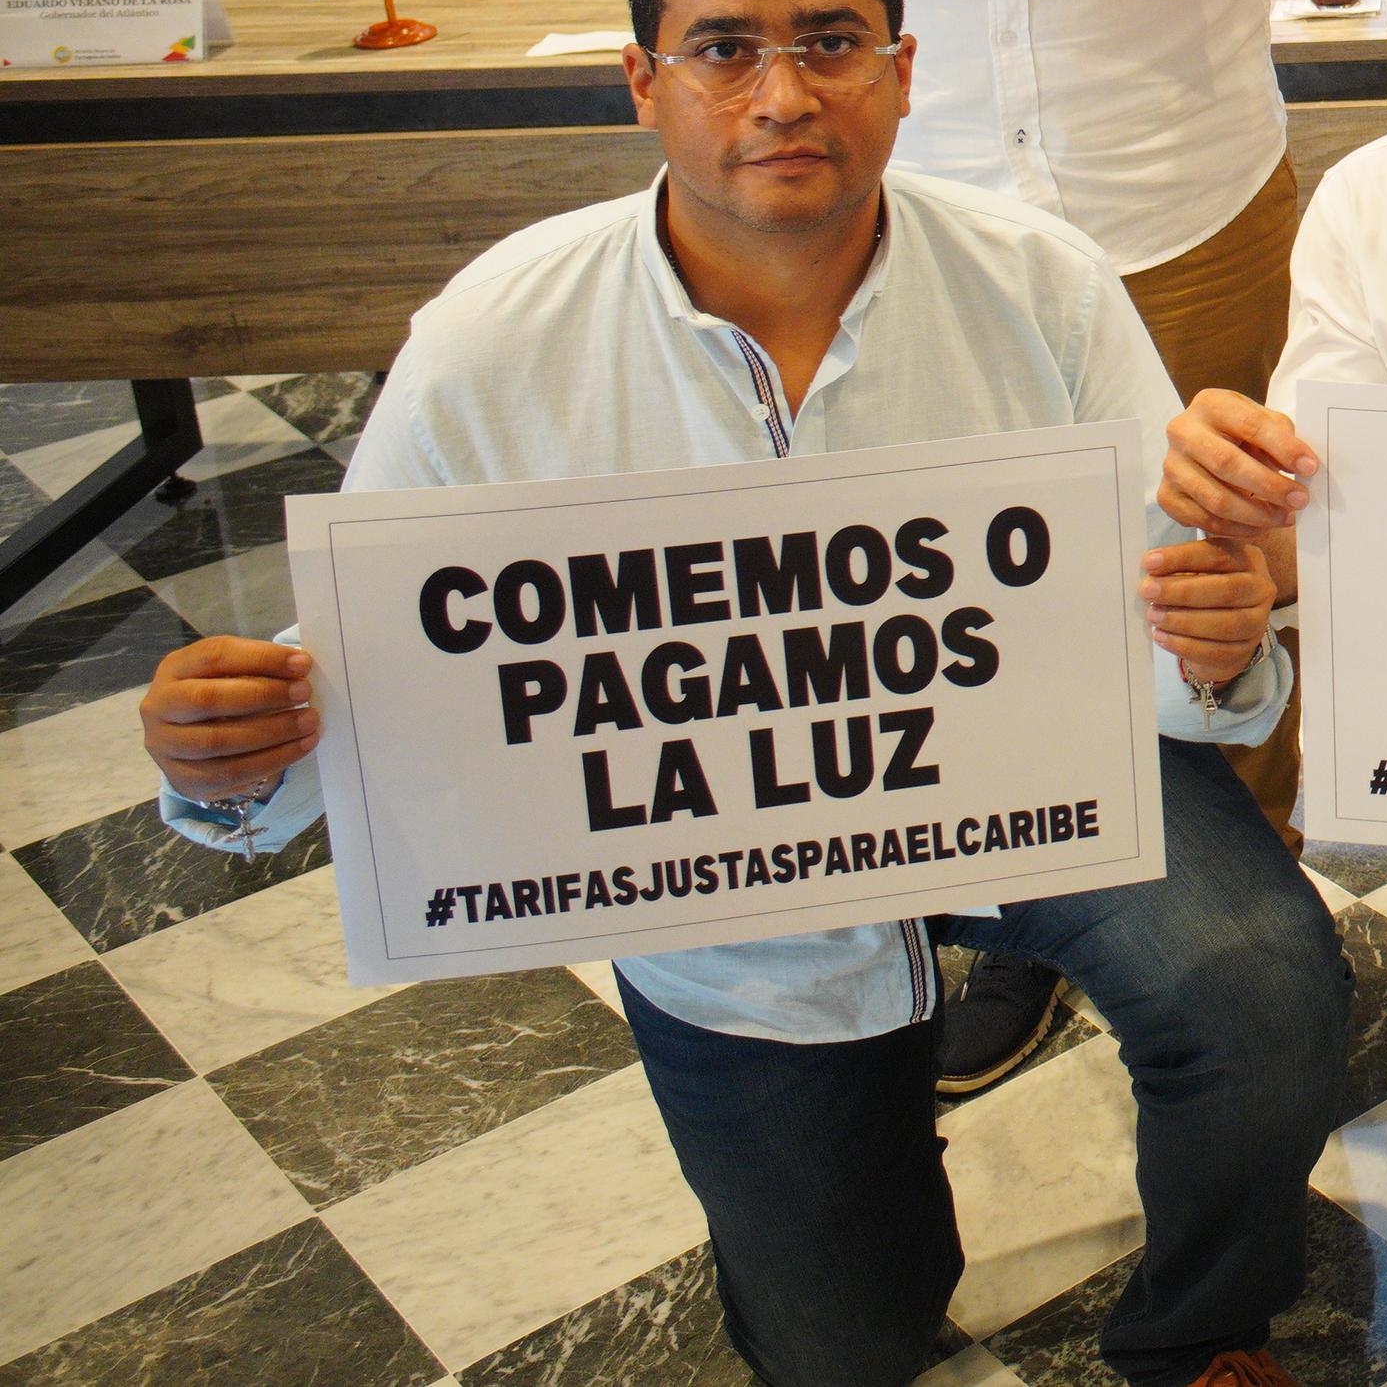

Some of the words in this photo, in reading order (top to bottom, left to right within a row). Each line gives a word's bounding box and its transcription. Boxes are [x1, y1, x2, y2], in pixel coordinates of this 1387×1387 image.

[7, 0, 68, 9] EDUARDO
[420, 517, 954, 654] COMEMOS
[986, 507, 1050, 587] O
[498, 607, 999, 745] PAGAMOS
[582, 739, 718, 832] LA
[749, 707, 940, 809] LUZ
[425, 800, 1099, 927] #TARIFASJUSTASPARAELCARIBE
